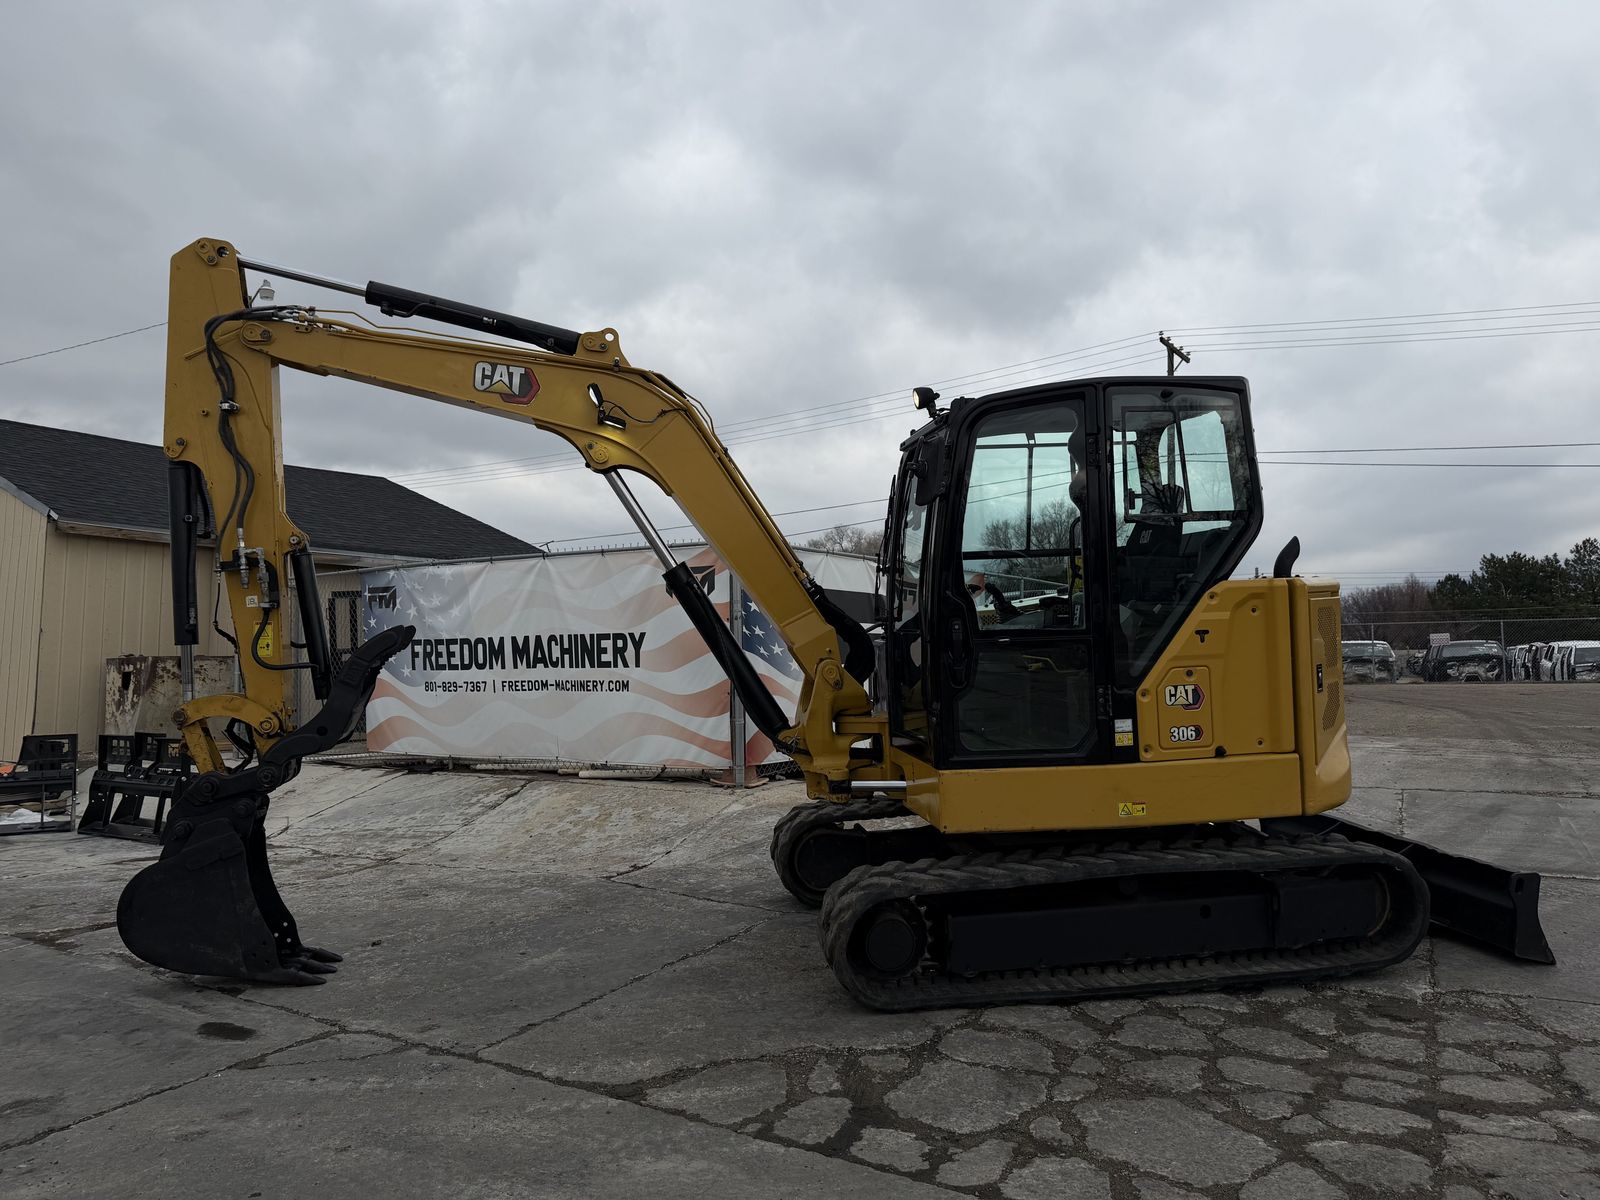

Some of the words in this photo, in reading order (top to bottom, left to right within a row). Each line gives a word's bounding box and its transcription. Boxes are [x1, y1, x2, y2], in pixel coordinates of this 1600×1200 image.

[474, 361, 525, 395] CAT
[411, 637, 506, 671] FREEDOM
[511, 632, 646, 669] MACHINERY
[424, 681, 487, 693] 801-829-7367
[501, 679, 630, 693] FREEDOM-MACHINERY.COM
[1165, 684, 1195, 706] CAT
[1170, 726, 1196, 742] 306
